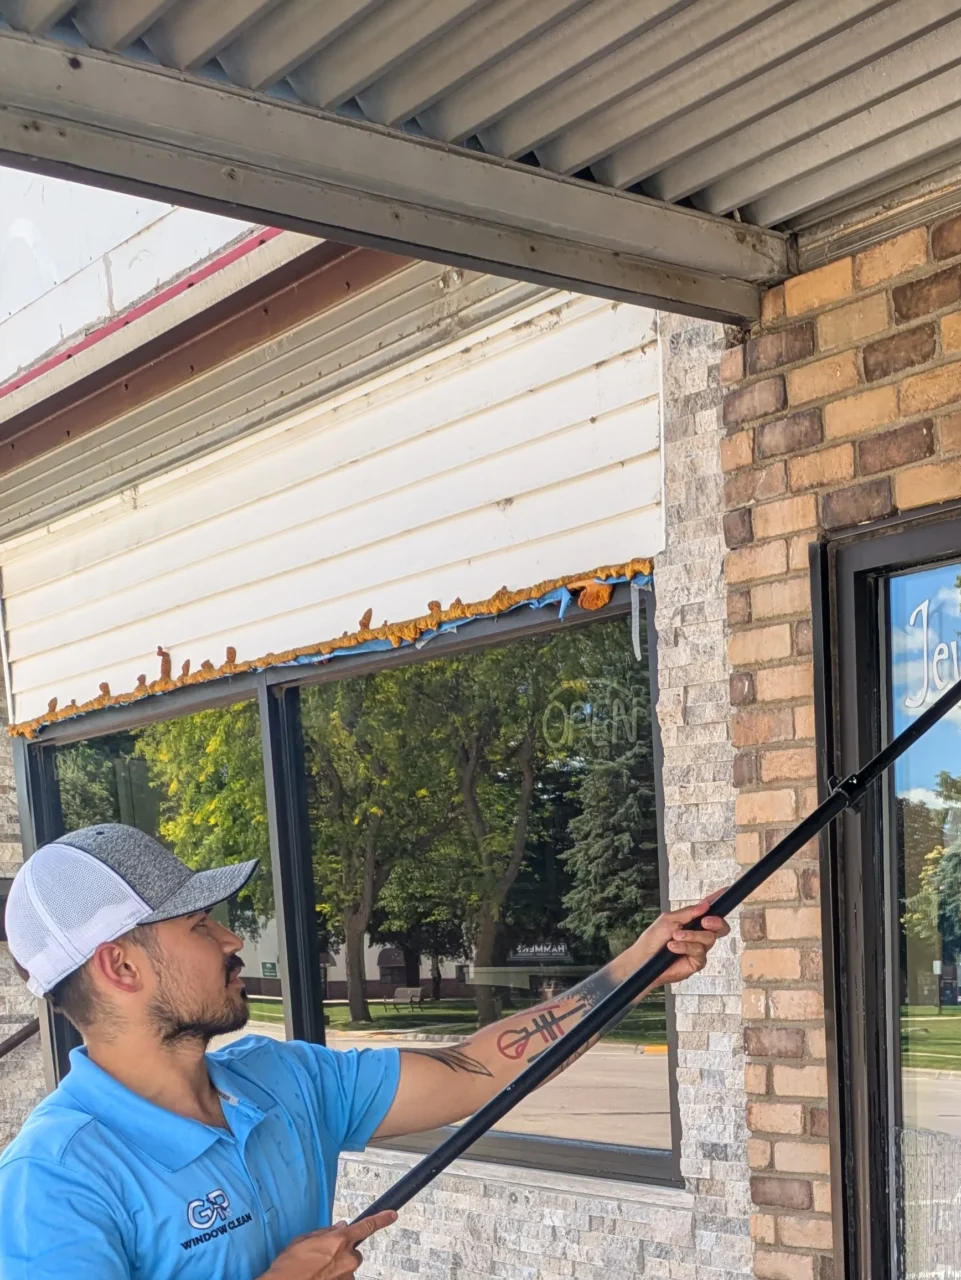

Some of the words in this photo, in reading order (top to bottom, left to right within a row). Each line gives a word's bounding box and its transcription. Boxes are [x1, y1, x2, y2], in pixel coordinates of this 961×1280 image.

[543, 699, 638, 749] OPEN
[180, 1224, 228, 1251] WINDOW
[227, 1212, 253, 1231] CLEAN
